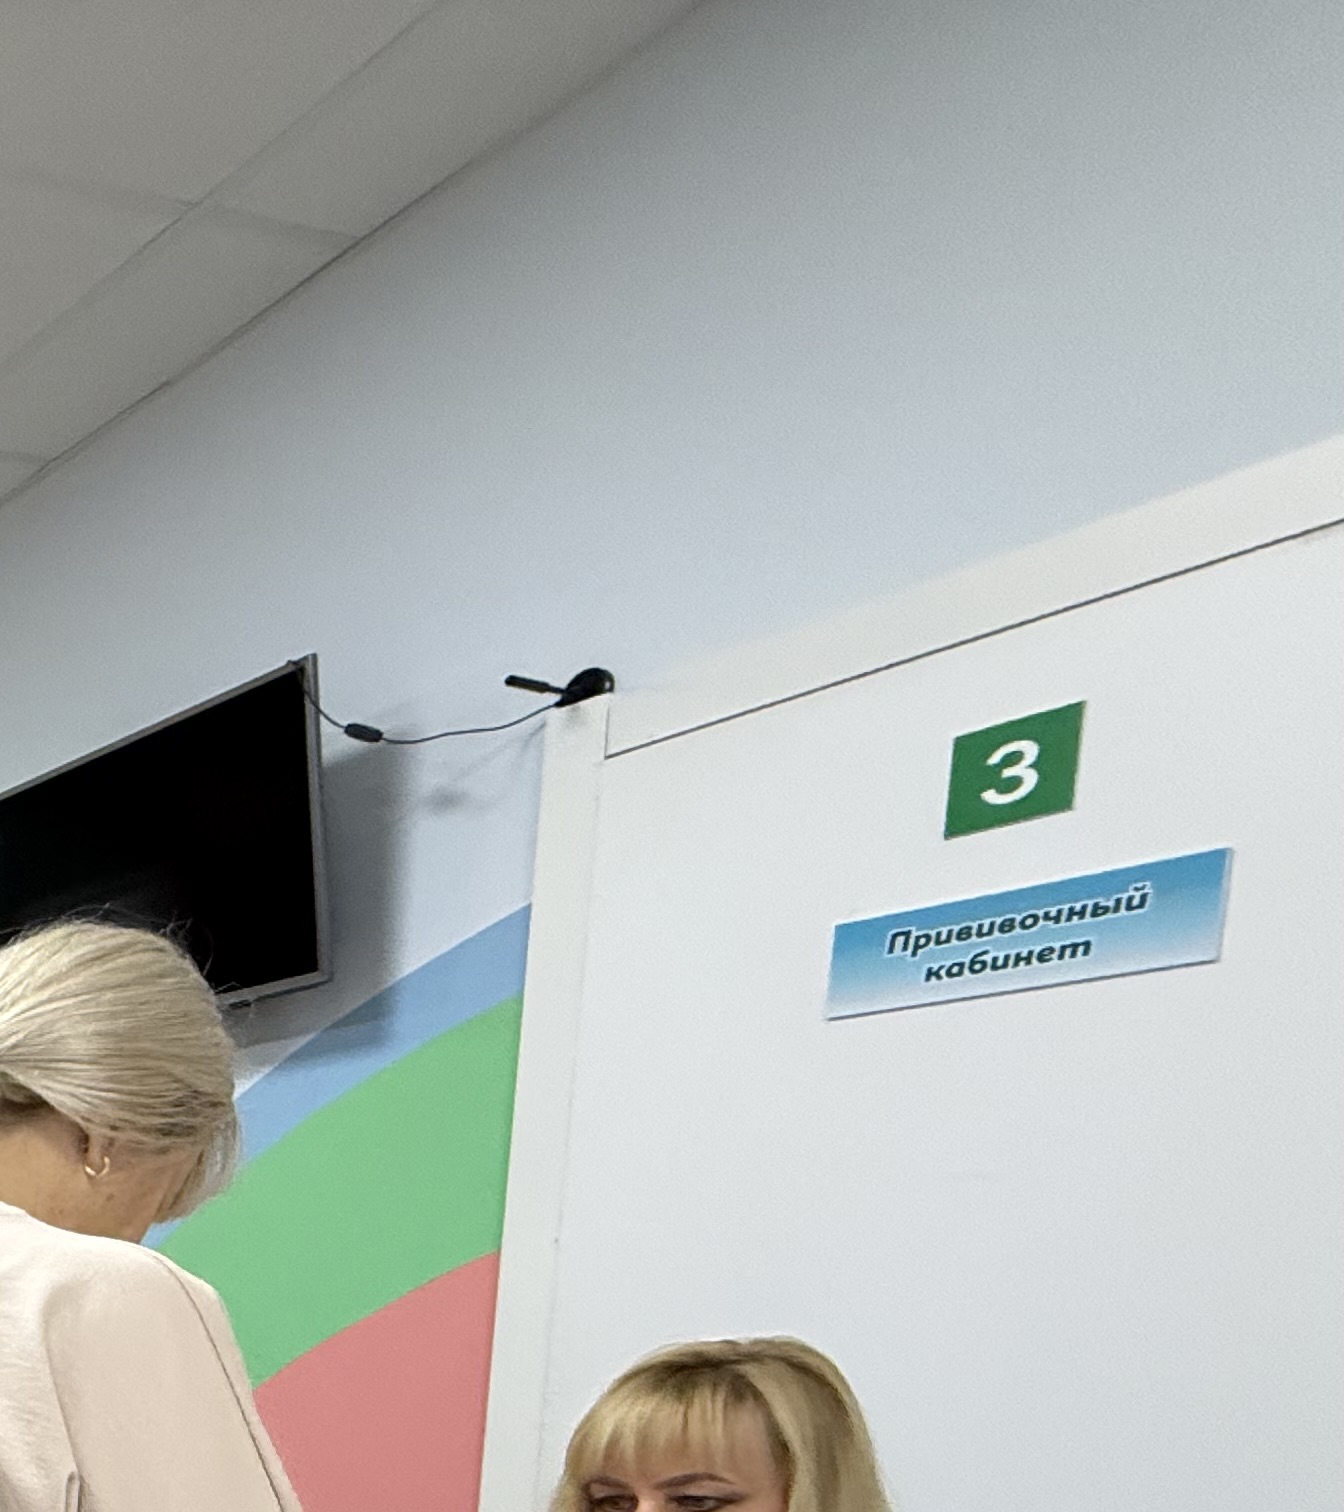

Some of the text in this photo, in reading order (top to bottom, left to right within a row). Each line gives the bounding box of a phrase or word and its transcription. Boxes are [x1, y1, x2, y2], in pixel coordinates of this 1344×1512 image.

[979, 739, 1041, 806] 3
[886, 883, 1153, 958] Прививочный
[923, 939, 1093, 984] кабинет
